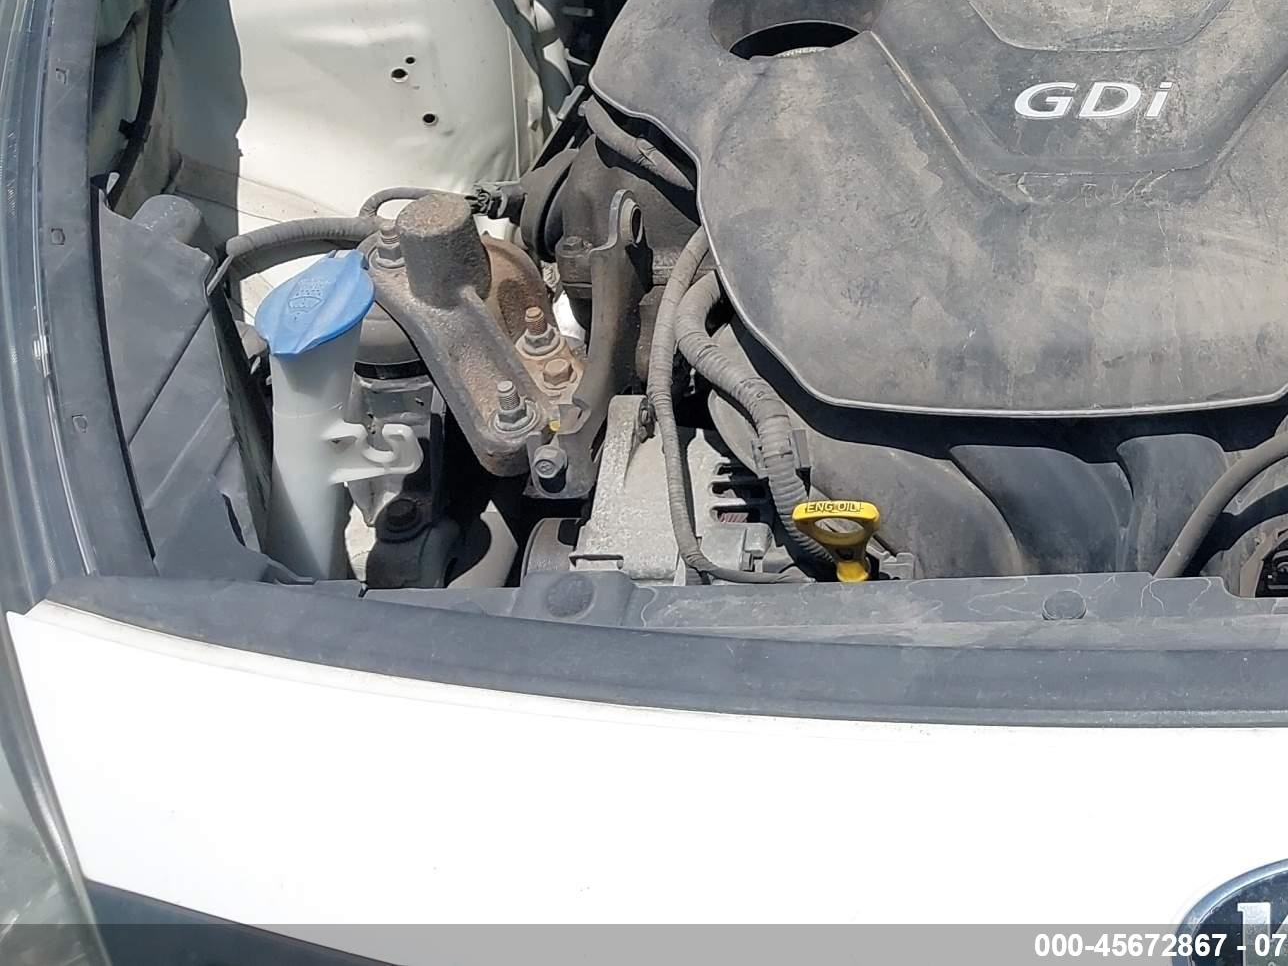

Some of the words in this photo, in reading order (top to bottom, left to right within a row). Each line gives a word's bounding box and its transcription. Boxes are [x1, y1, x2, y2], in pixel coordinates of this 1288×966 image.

[1014, 81, 1173, 119] GDi
[806, 501, 834, 514] ENG
[837, 500, 859, 513] OIL
